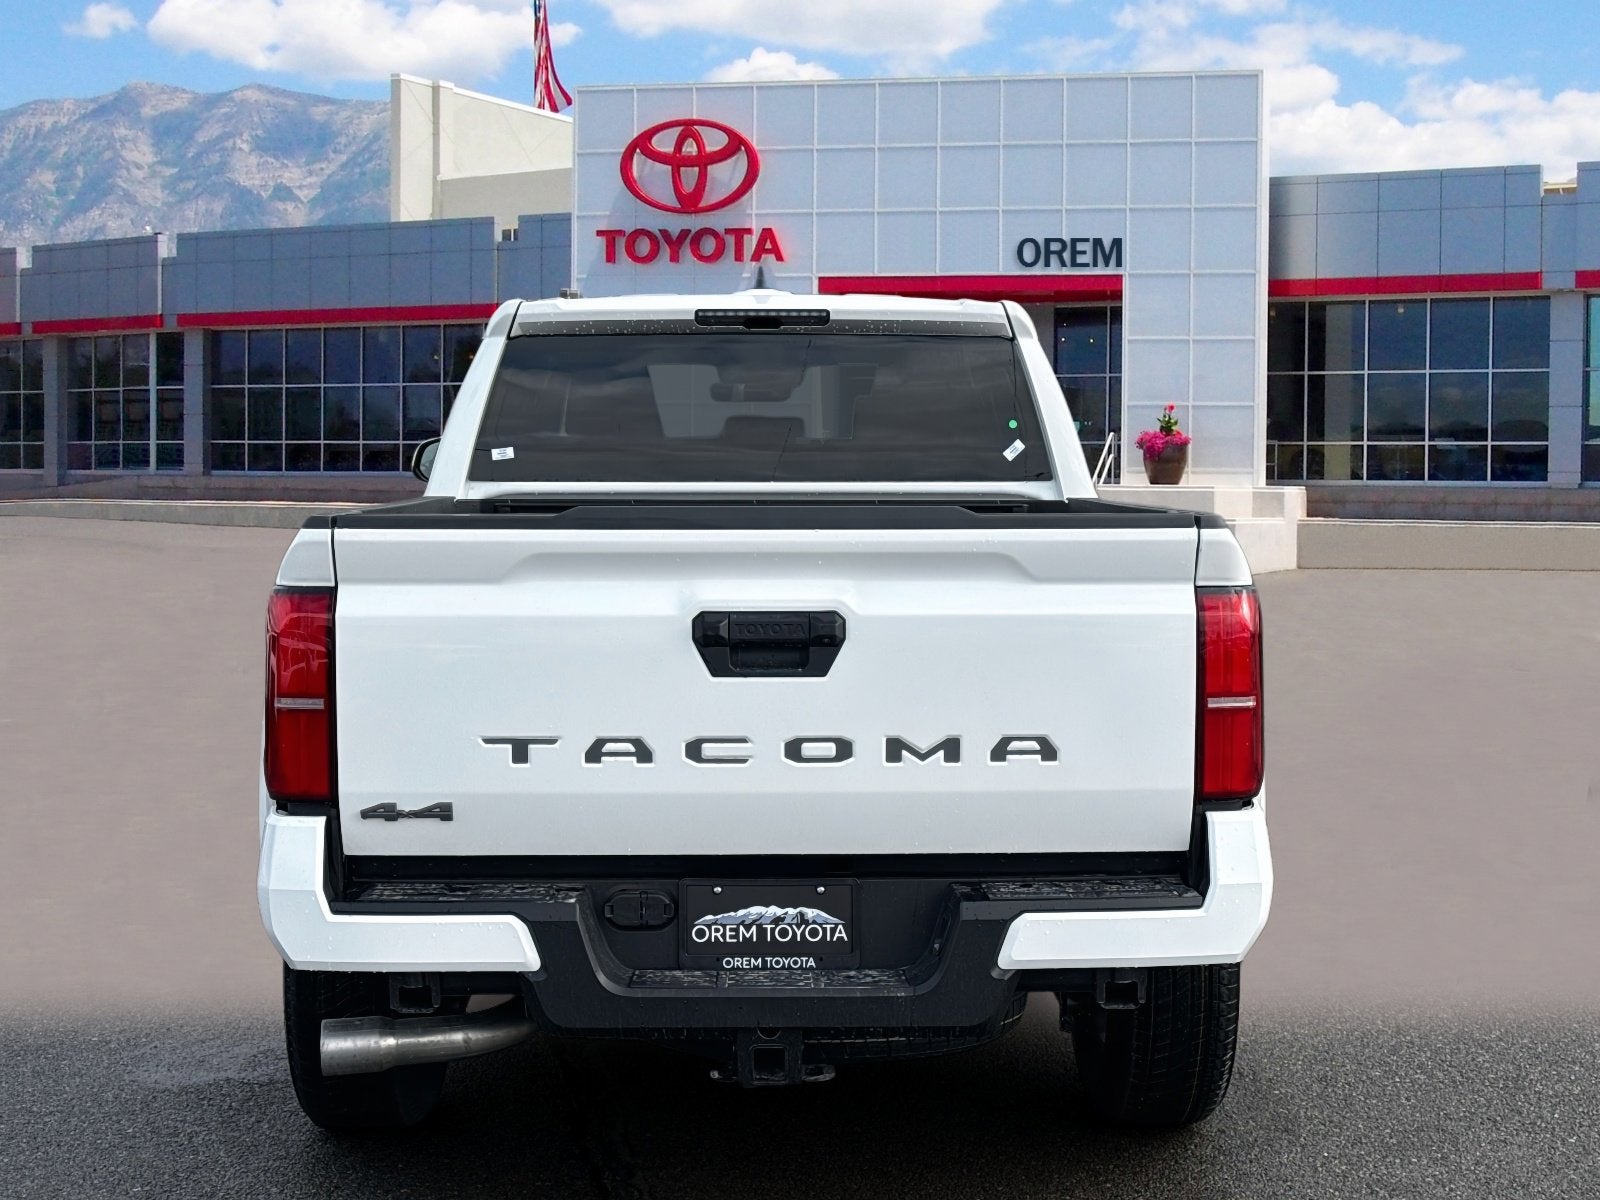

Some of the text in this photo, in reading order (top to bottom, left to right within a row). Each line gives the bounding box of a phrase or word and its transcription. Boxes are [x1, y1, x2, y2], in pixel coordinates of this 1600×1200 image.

[596, 227, 785, 264] TOYOTA
[1016, 237, 1123, 269] OREM
[734, 622, 807, 637] TOYOTA
[480, 735, 1061, 767] TACOMA
[692, 924, 848, 943] OREM TOYOTA
[722, 958, 816, 969] OREM TOYOTA
